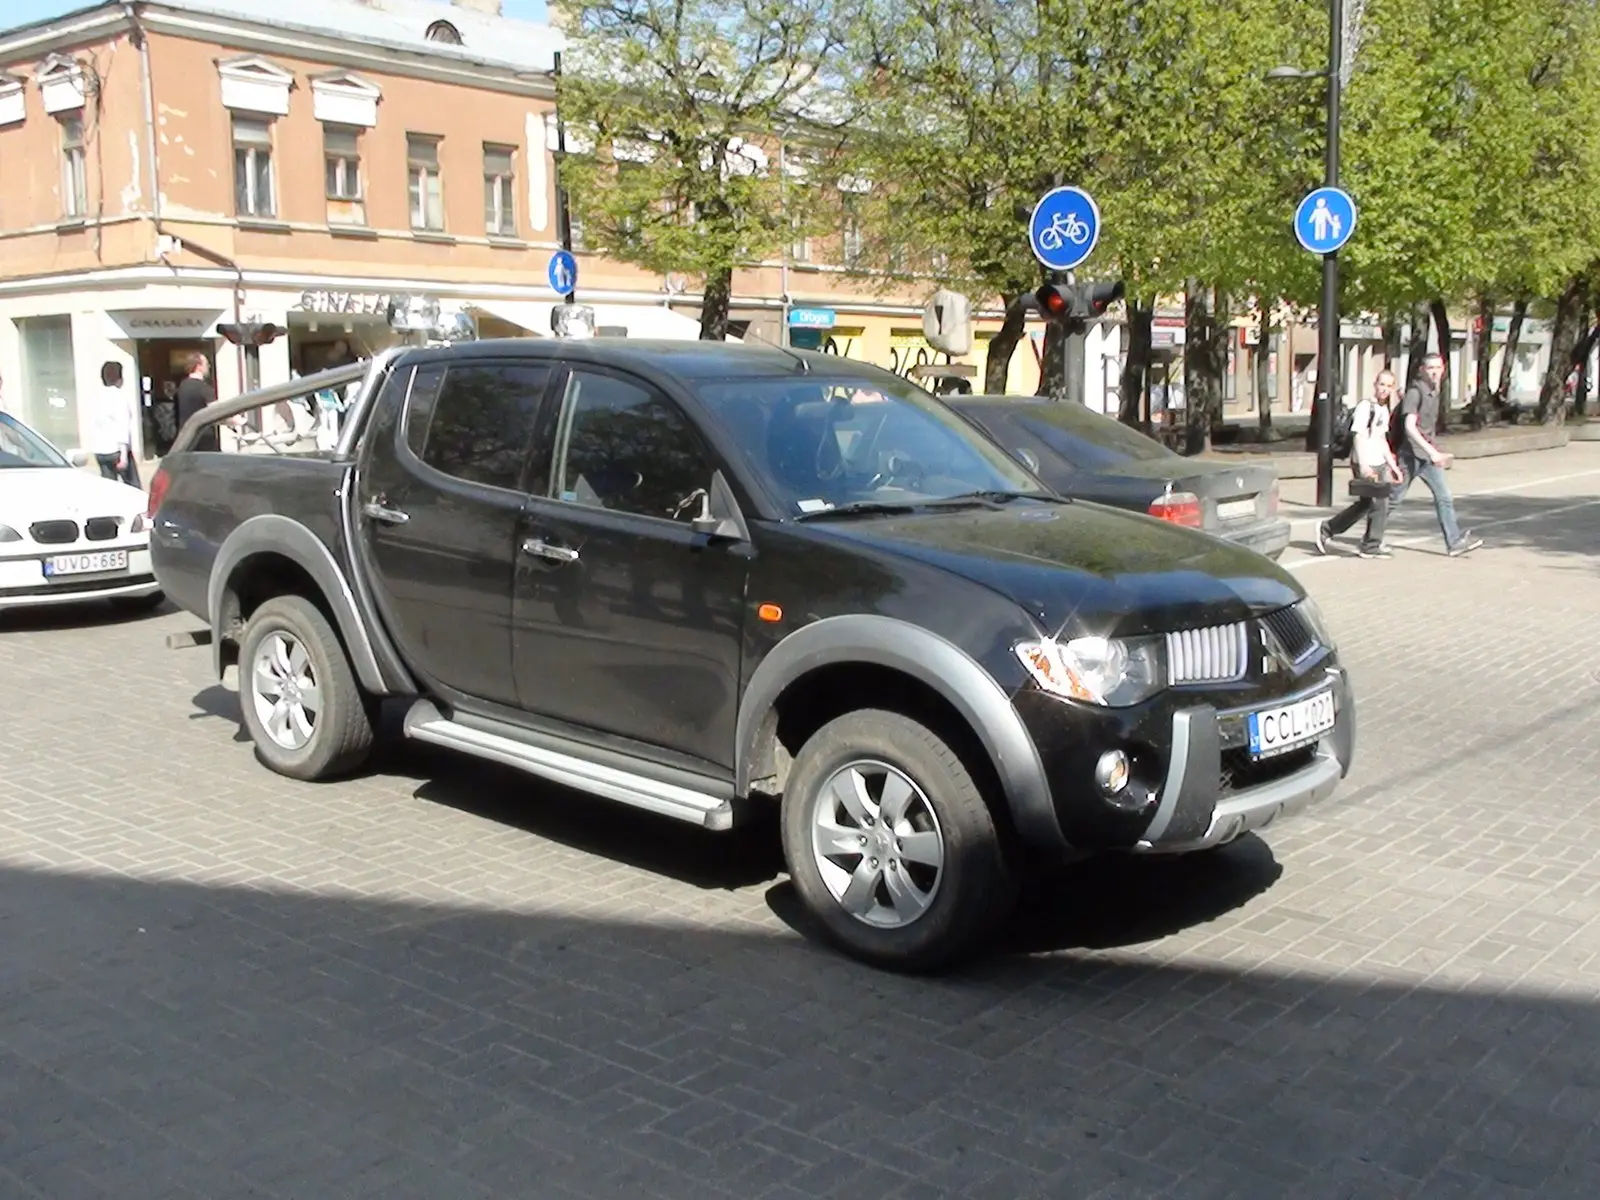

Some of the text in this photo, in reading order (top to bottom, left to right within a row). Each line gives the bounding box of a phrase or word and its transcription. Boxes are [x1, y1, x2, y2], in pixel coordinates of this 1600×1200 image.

[57, 552, 125, 571] UVD 685
[1263, 709, 1302, 743] CCL
